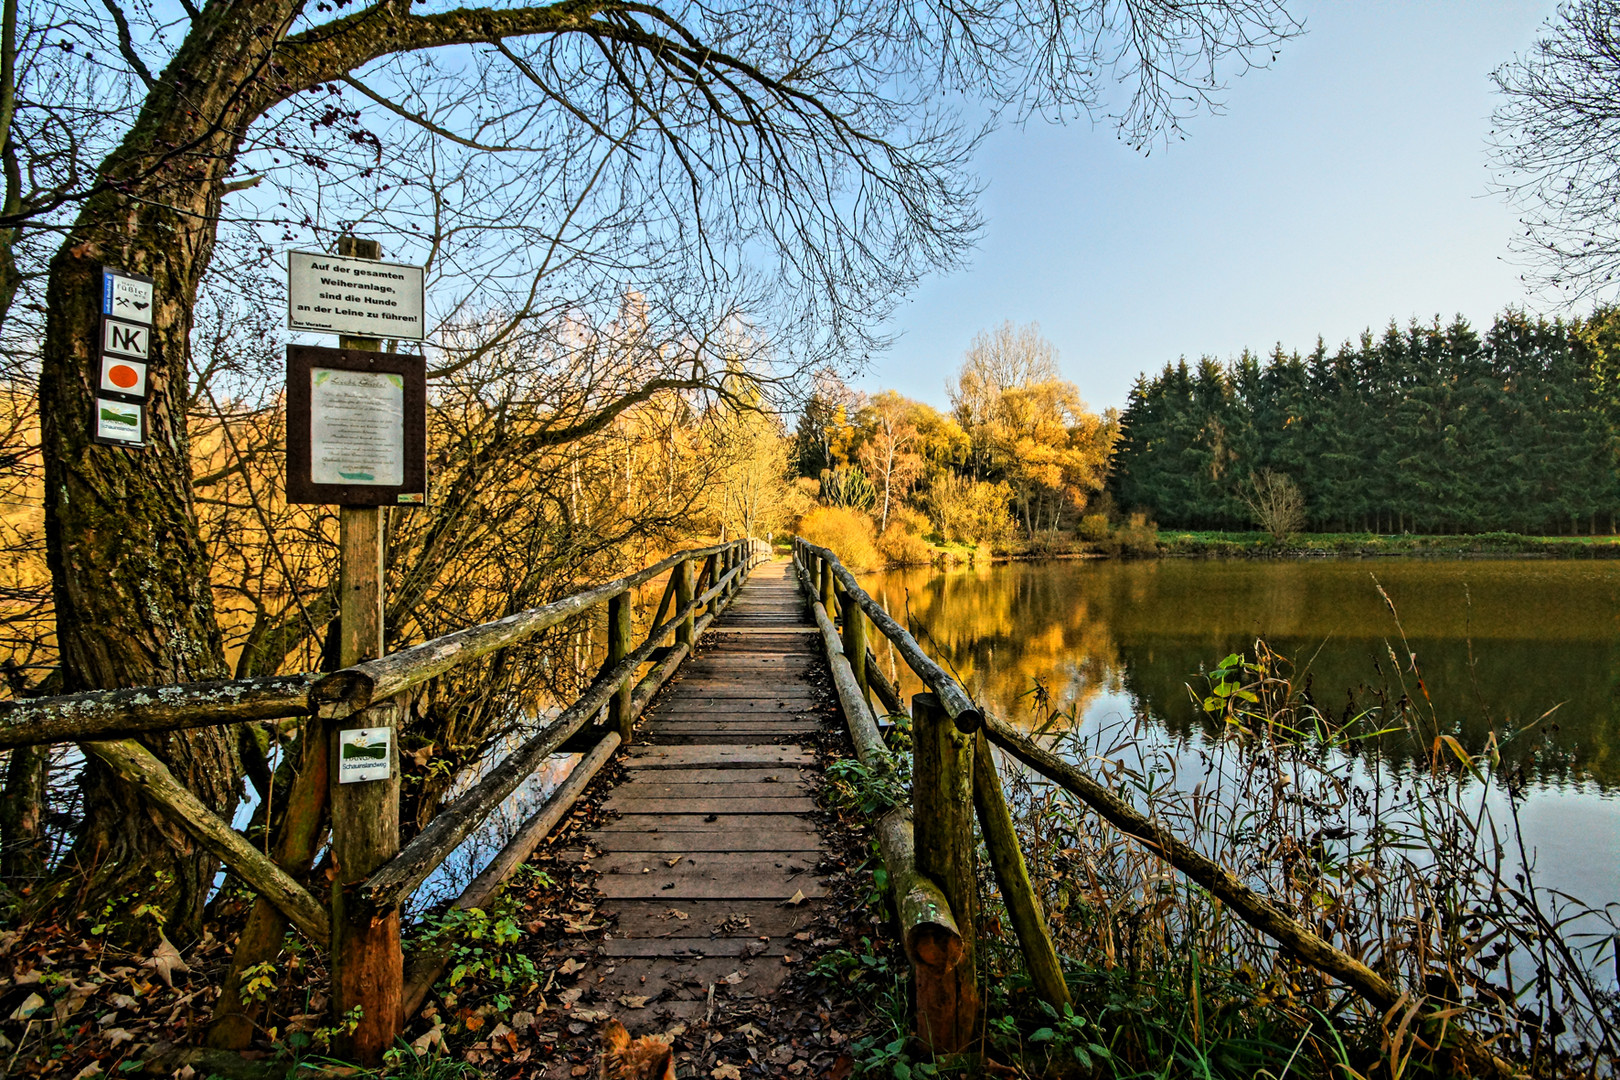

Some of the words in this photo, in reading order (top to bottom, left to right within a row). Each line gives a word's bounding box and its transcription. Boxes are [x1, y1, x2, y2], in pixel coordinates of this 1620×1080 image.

[311, 262, 329, 271] Auf
[333, 265, 351, 274] der
[353, 269, 405, 281] gesamten
[320, 277, 396, 294] Weiheranlage,
[319, 292, 342, 301] sind
[345, 295, 361, 303] die
[364, 296, 398, 307] Hunde
[297, 304, 311, 312] an
[314, 305, 332, 314] der
[335, 307, 364, 317] Leine
[367, 311, 379, 319] zu
[381, 312, 418, 323] führen!
